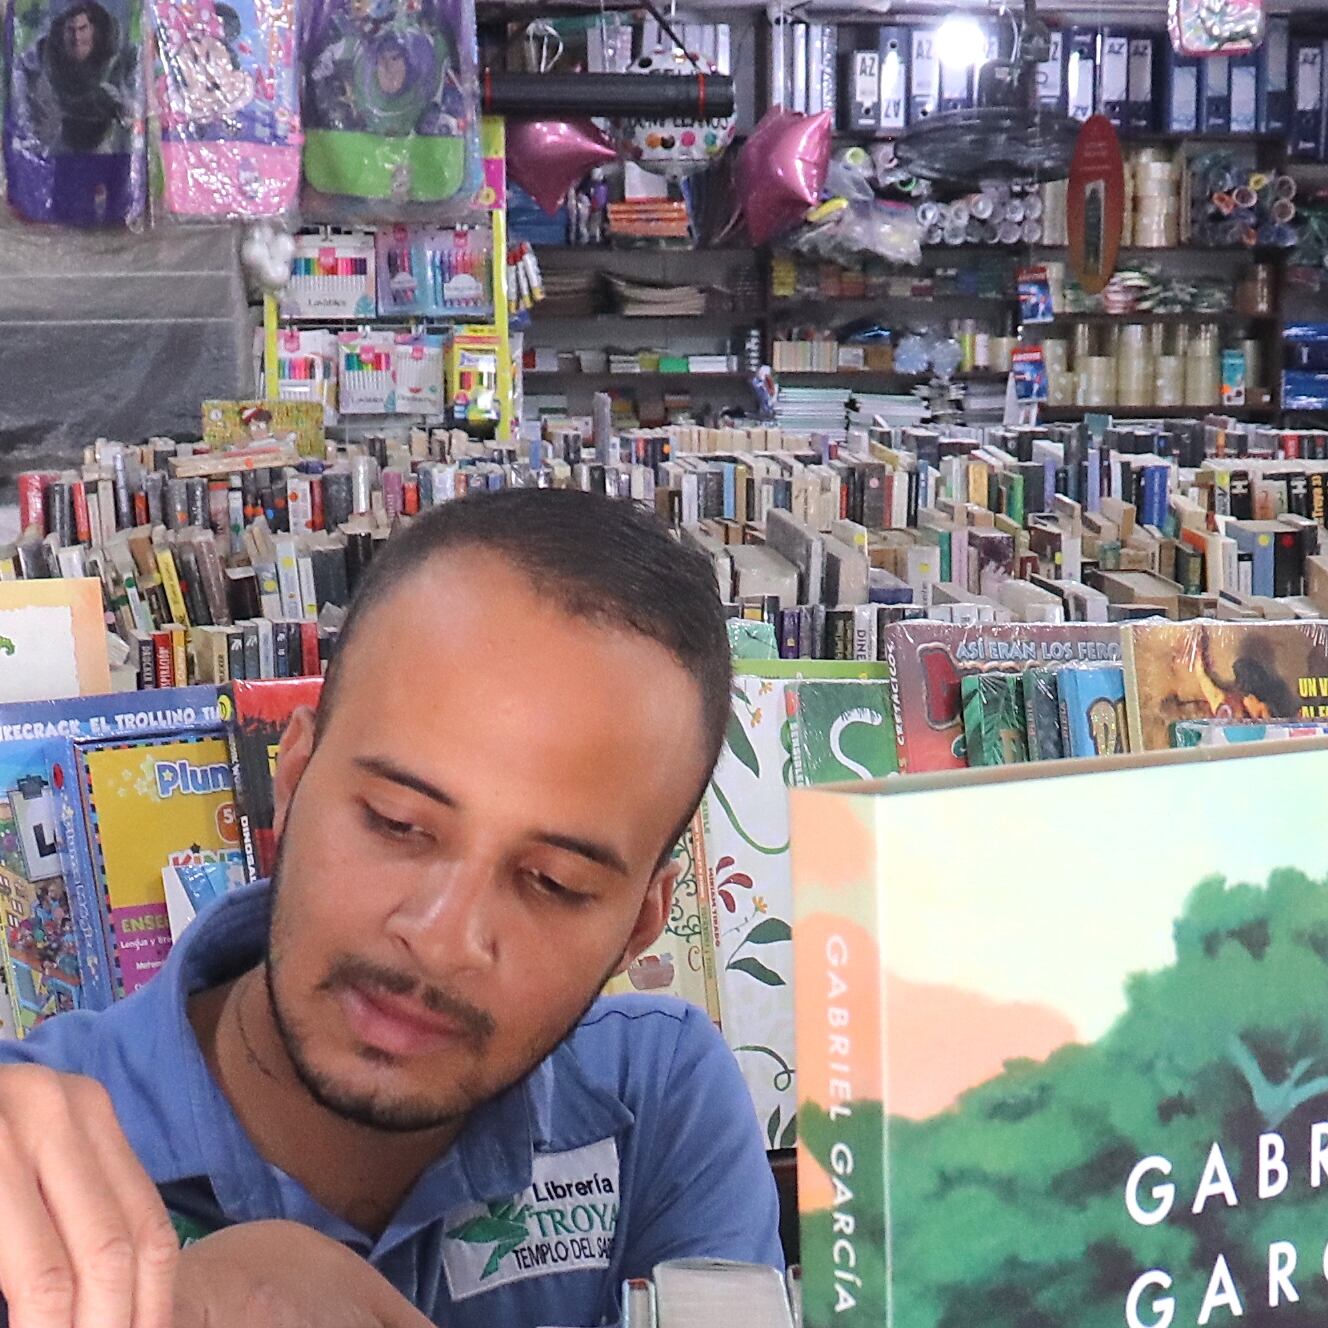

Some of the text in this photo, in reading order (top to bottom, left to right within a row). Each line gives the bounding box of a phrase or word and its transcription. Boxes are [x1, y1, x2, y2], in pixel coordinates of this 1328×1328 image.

[857, 629, 867, 661] DINE
[957, 638, 1121, 660] ASÍ ERAN LOS FERO
[1298, 677, 1317, 697] UN
[90, 716, 110, 733] EL
[115, 706, 196, 730] TROLLINO
[825, 934, 852, 1122] GABRIEL
[532, 1173, 614, 1202] Librería
[828, 1142, 857, 1314] GARCÍA
[513, 1240, 569, 1270] TEMPLO
[570, 1237, 596, 1259] DEL
